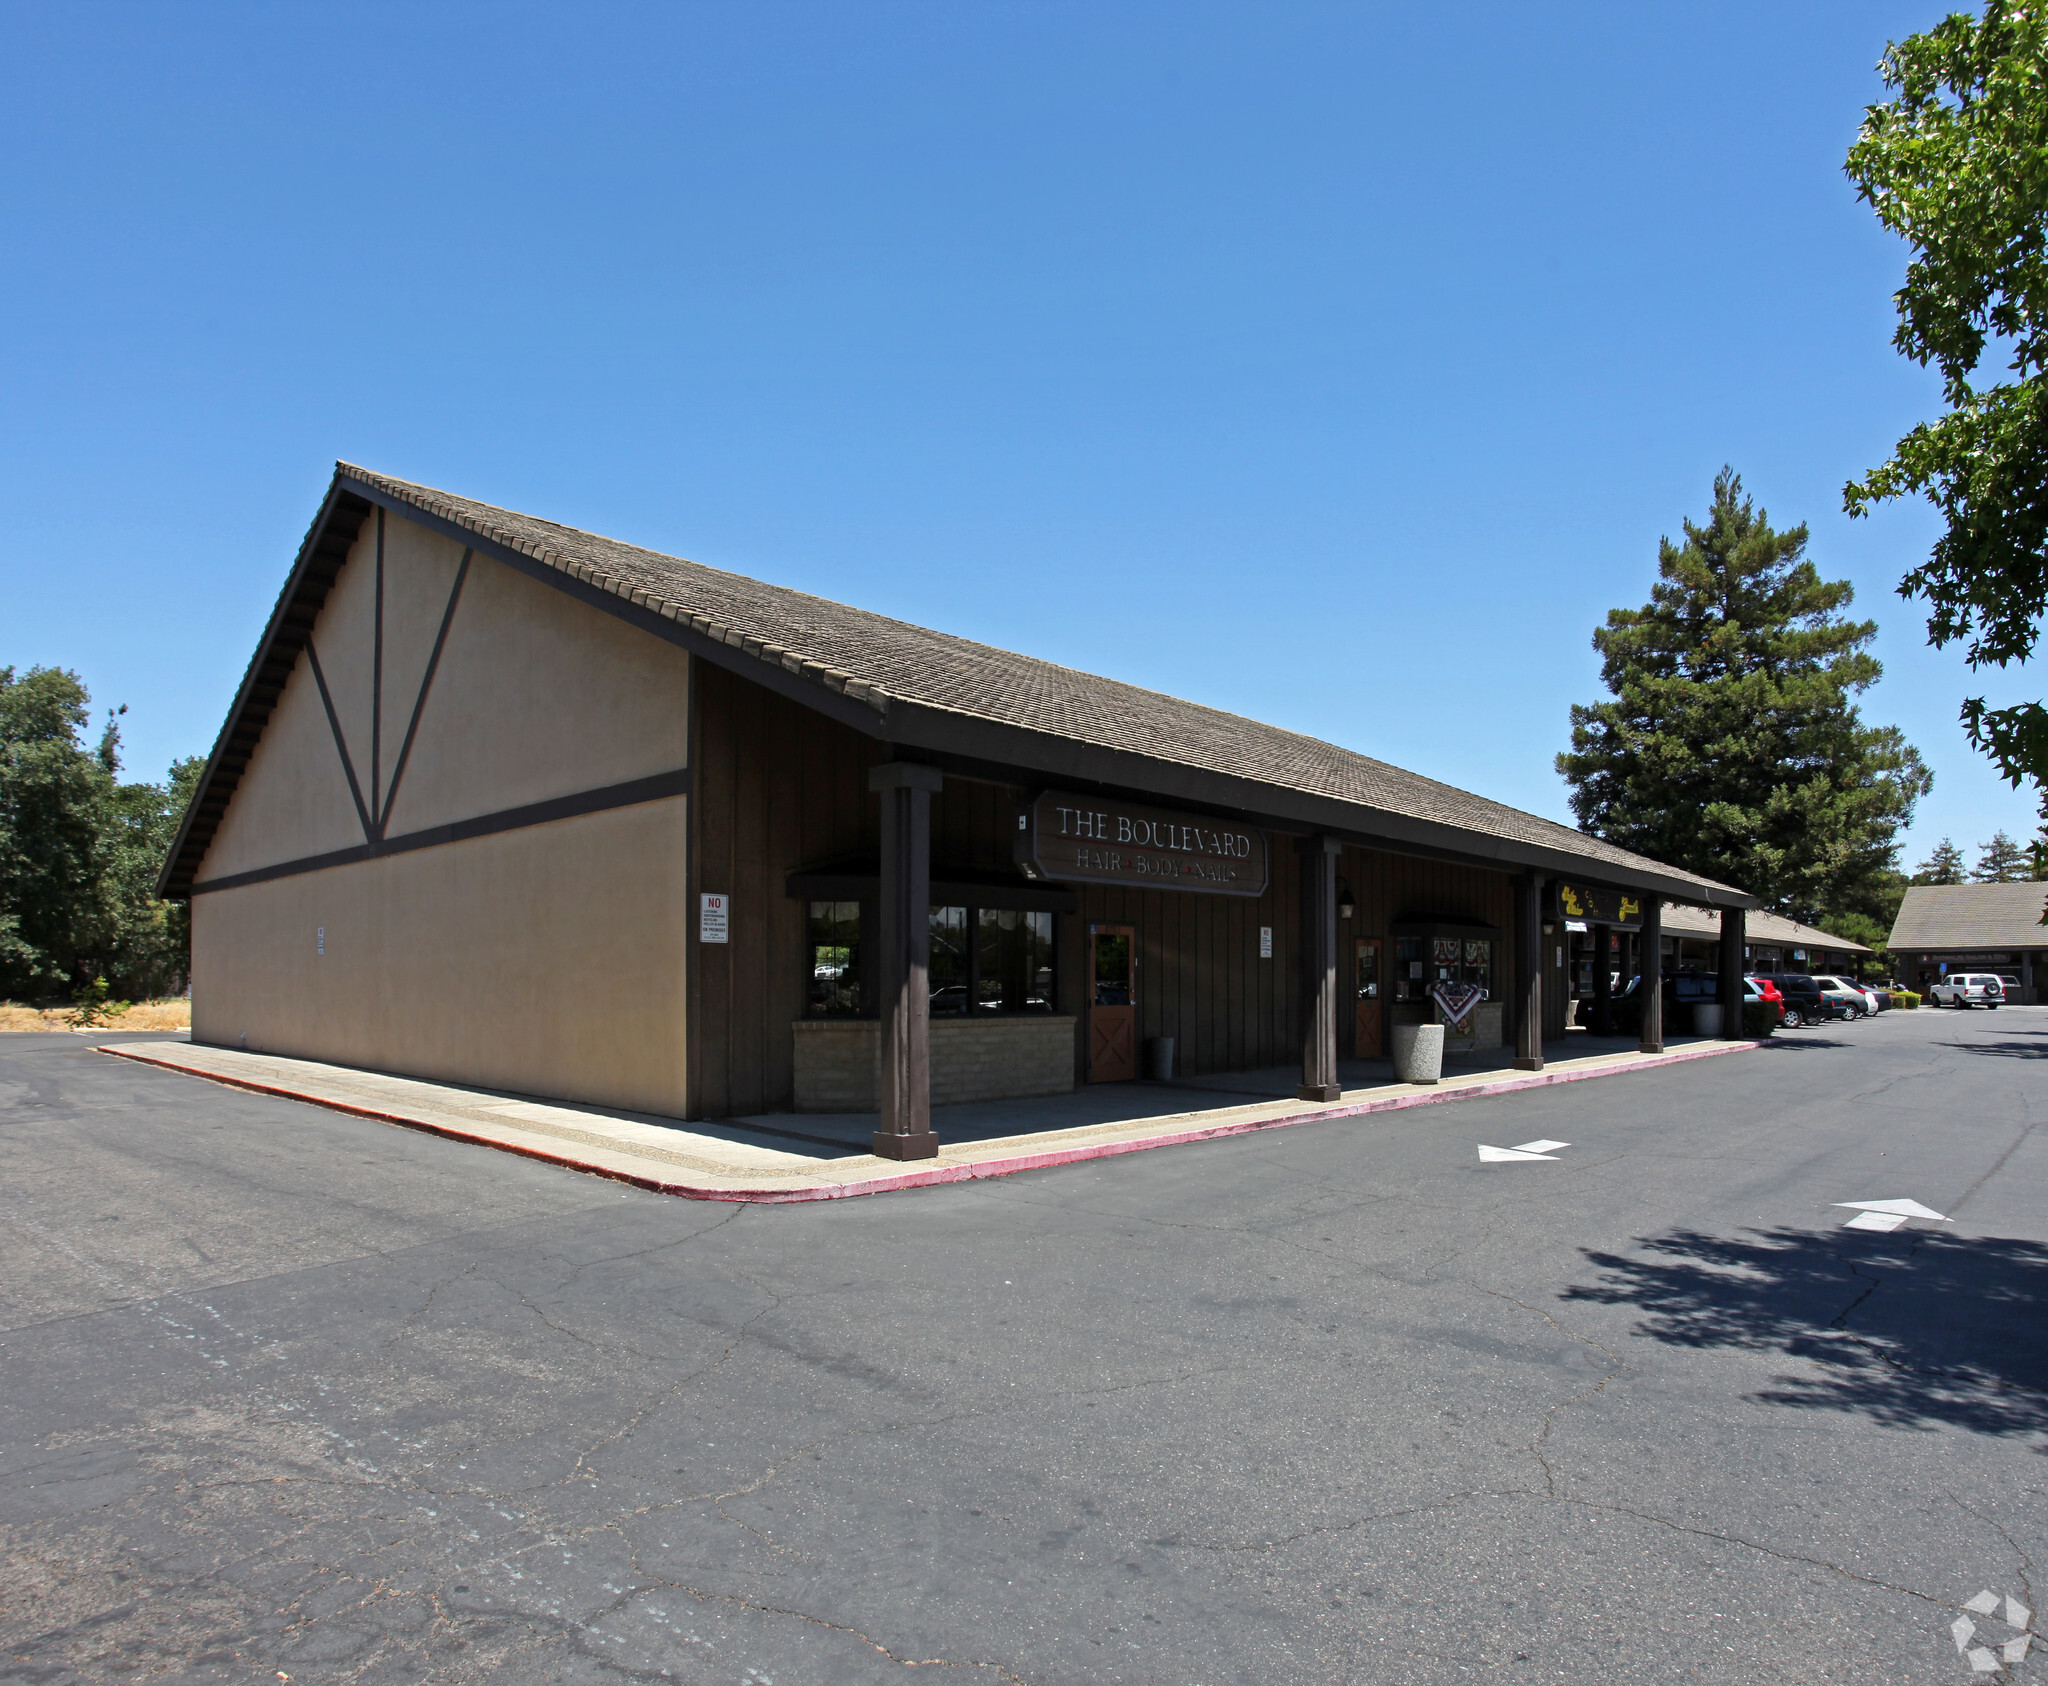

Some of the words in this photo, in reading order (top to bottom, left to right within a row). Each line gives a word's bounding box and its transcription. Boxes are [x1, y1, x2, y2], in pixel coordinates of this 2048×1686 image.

[1056, 807, 1109, 840] THE
[1116, 816, 1251, 858] BOULEVARD
[1077, 849, 1122, 871] HAIR
[1137, 856, 1183, 878] BODY
[1195, 863, 1238, 882] NAILS
[708, 898, 721, 908] NO
